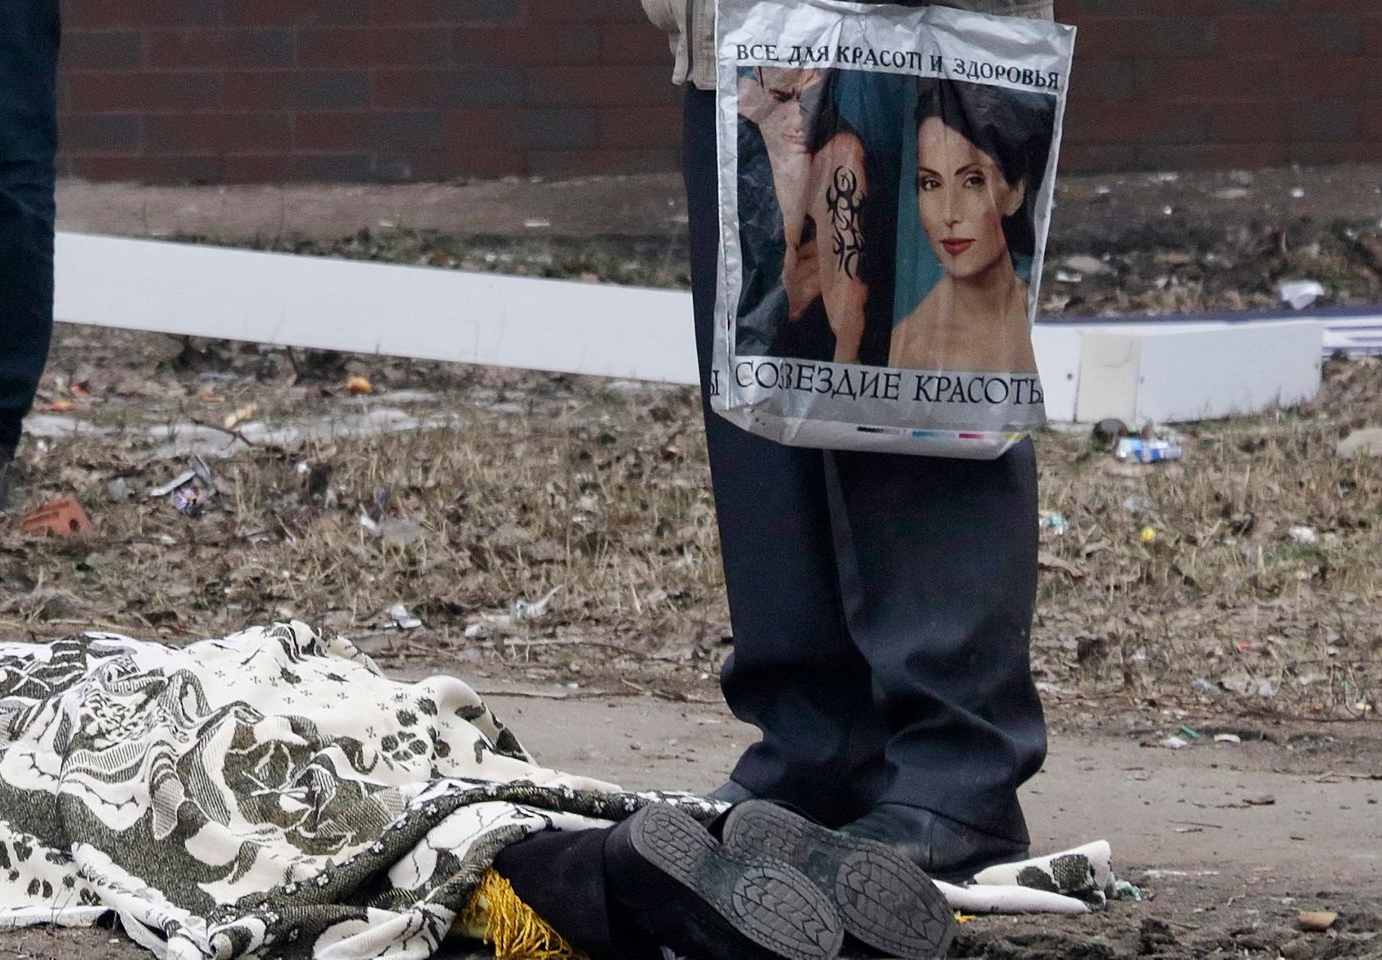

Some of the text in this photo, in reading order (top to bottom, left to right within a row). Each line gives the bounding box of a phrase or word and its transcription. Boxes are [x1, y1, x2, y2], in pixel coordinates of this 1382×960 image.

[736, 44, 779, 62] ВСЕ
[787, 45, 830, 66] ДЛЯ
[929, 54, 943, 73] И
[953, 58, 1059, 90] ЗДОРОВЬЯ
